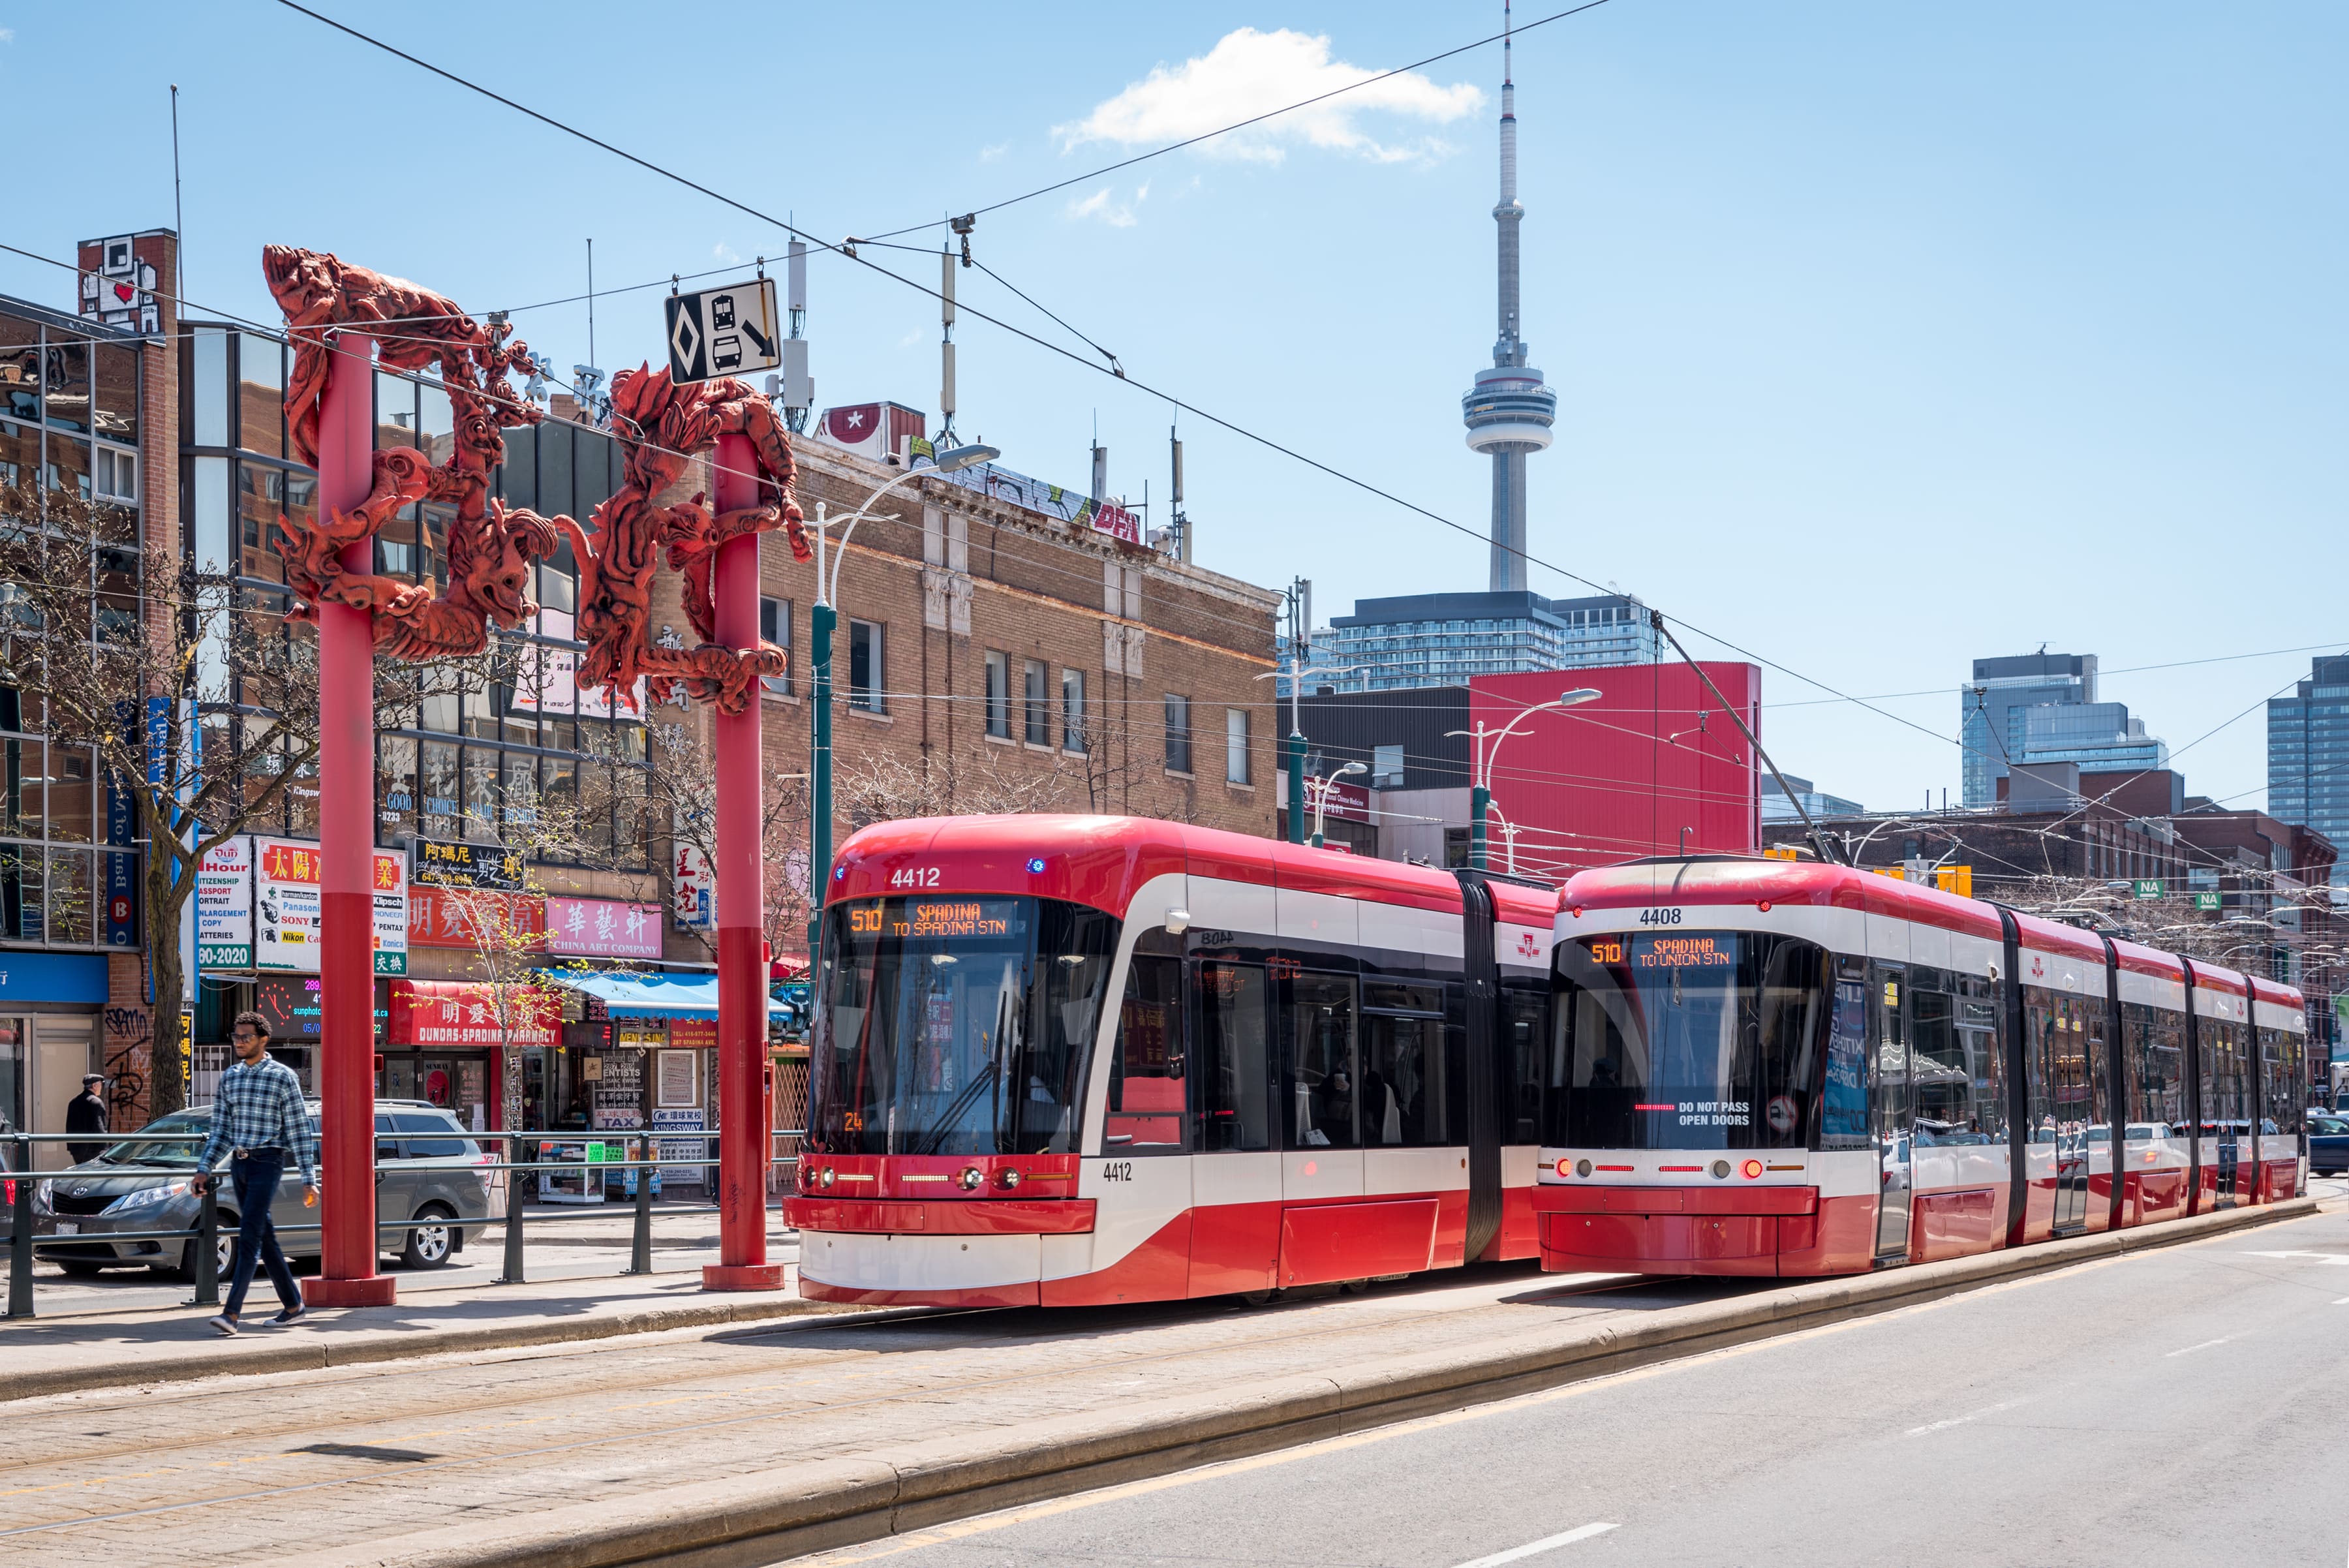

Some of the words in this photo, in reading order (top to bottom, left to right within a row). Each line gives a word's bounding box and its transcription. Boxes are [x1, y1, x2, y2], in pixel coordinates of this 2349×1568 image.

[387, 792, 412, 811] GOOD
[426, 797, 457, 816] CHOICE
[206, 863, 248, 872] Hour
[891, 867, 940, 887] 4412
[2140, 882, 2159, 893] NA
[281, 890, 318, 900] harman/kardon
[2200, 894, 2218, 904] NA
[283, 901, 320, 912] Panasoni
[374, 895, 403, 907] Klipsch
[281, 915, 309, 925] SONY
[851, 910, 882, 932] 510
[916, 903, 981, 923] SPADINA
[1640, 908, 1681, 925] 4408
[378, 923, 403, 932] PENTAX
[892, 922, 910, 937] TO
[914, 921, 975, 936] SPADINA
[978, 920, 1006, 935] STN
[283, 932, 304, 942] Nikon
[382, 939, 403, 948] Konica
[553, 940, 586, 951] CHINA
[589, 942, 609, 952] ART
[611, 944, 658, 955] COMPANY
[198, 947, 248, 964] 60-2020
[1591, 944, 1621, 963] 510
[1653, 938, 1715, 955] SPADINA
[1640, 954, 1657, 967] TO
[1659, 953, 1700, 966] UNION
[1703, 952, 1730, 966] STN
[374, 1009, 388, 1018] et.ca
[603, 1068, 641, 1077] ENTISTS
[1679, 1102, 1694, 1113] DO
[1696, 1102, 1719, 1113] NOT
[1721, 1102, 1749, 1113] PASS
[602, 1118, 635, 1128] TAX
[844, 1112, 863, 1131] 24
[1679, 1115, 1708, 1126] OPEN
[1712, 1115, 1749, 1126] DOORS
[1103, 1162, 1132, 1182] 4412
